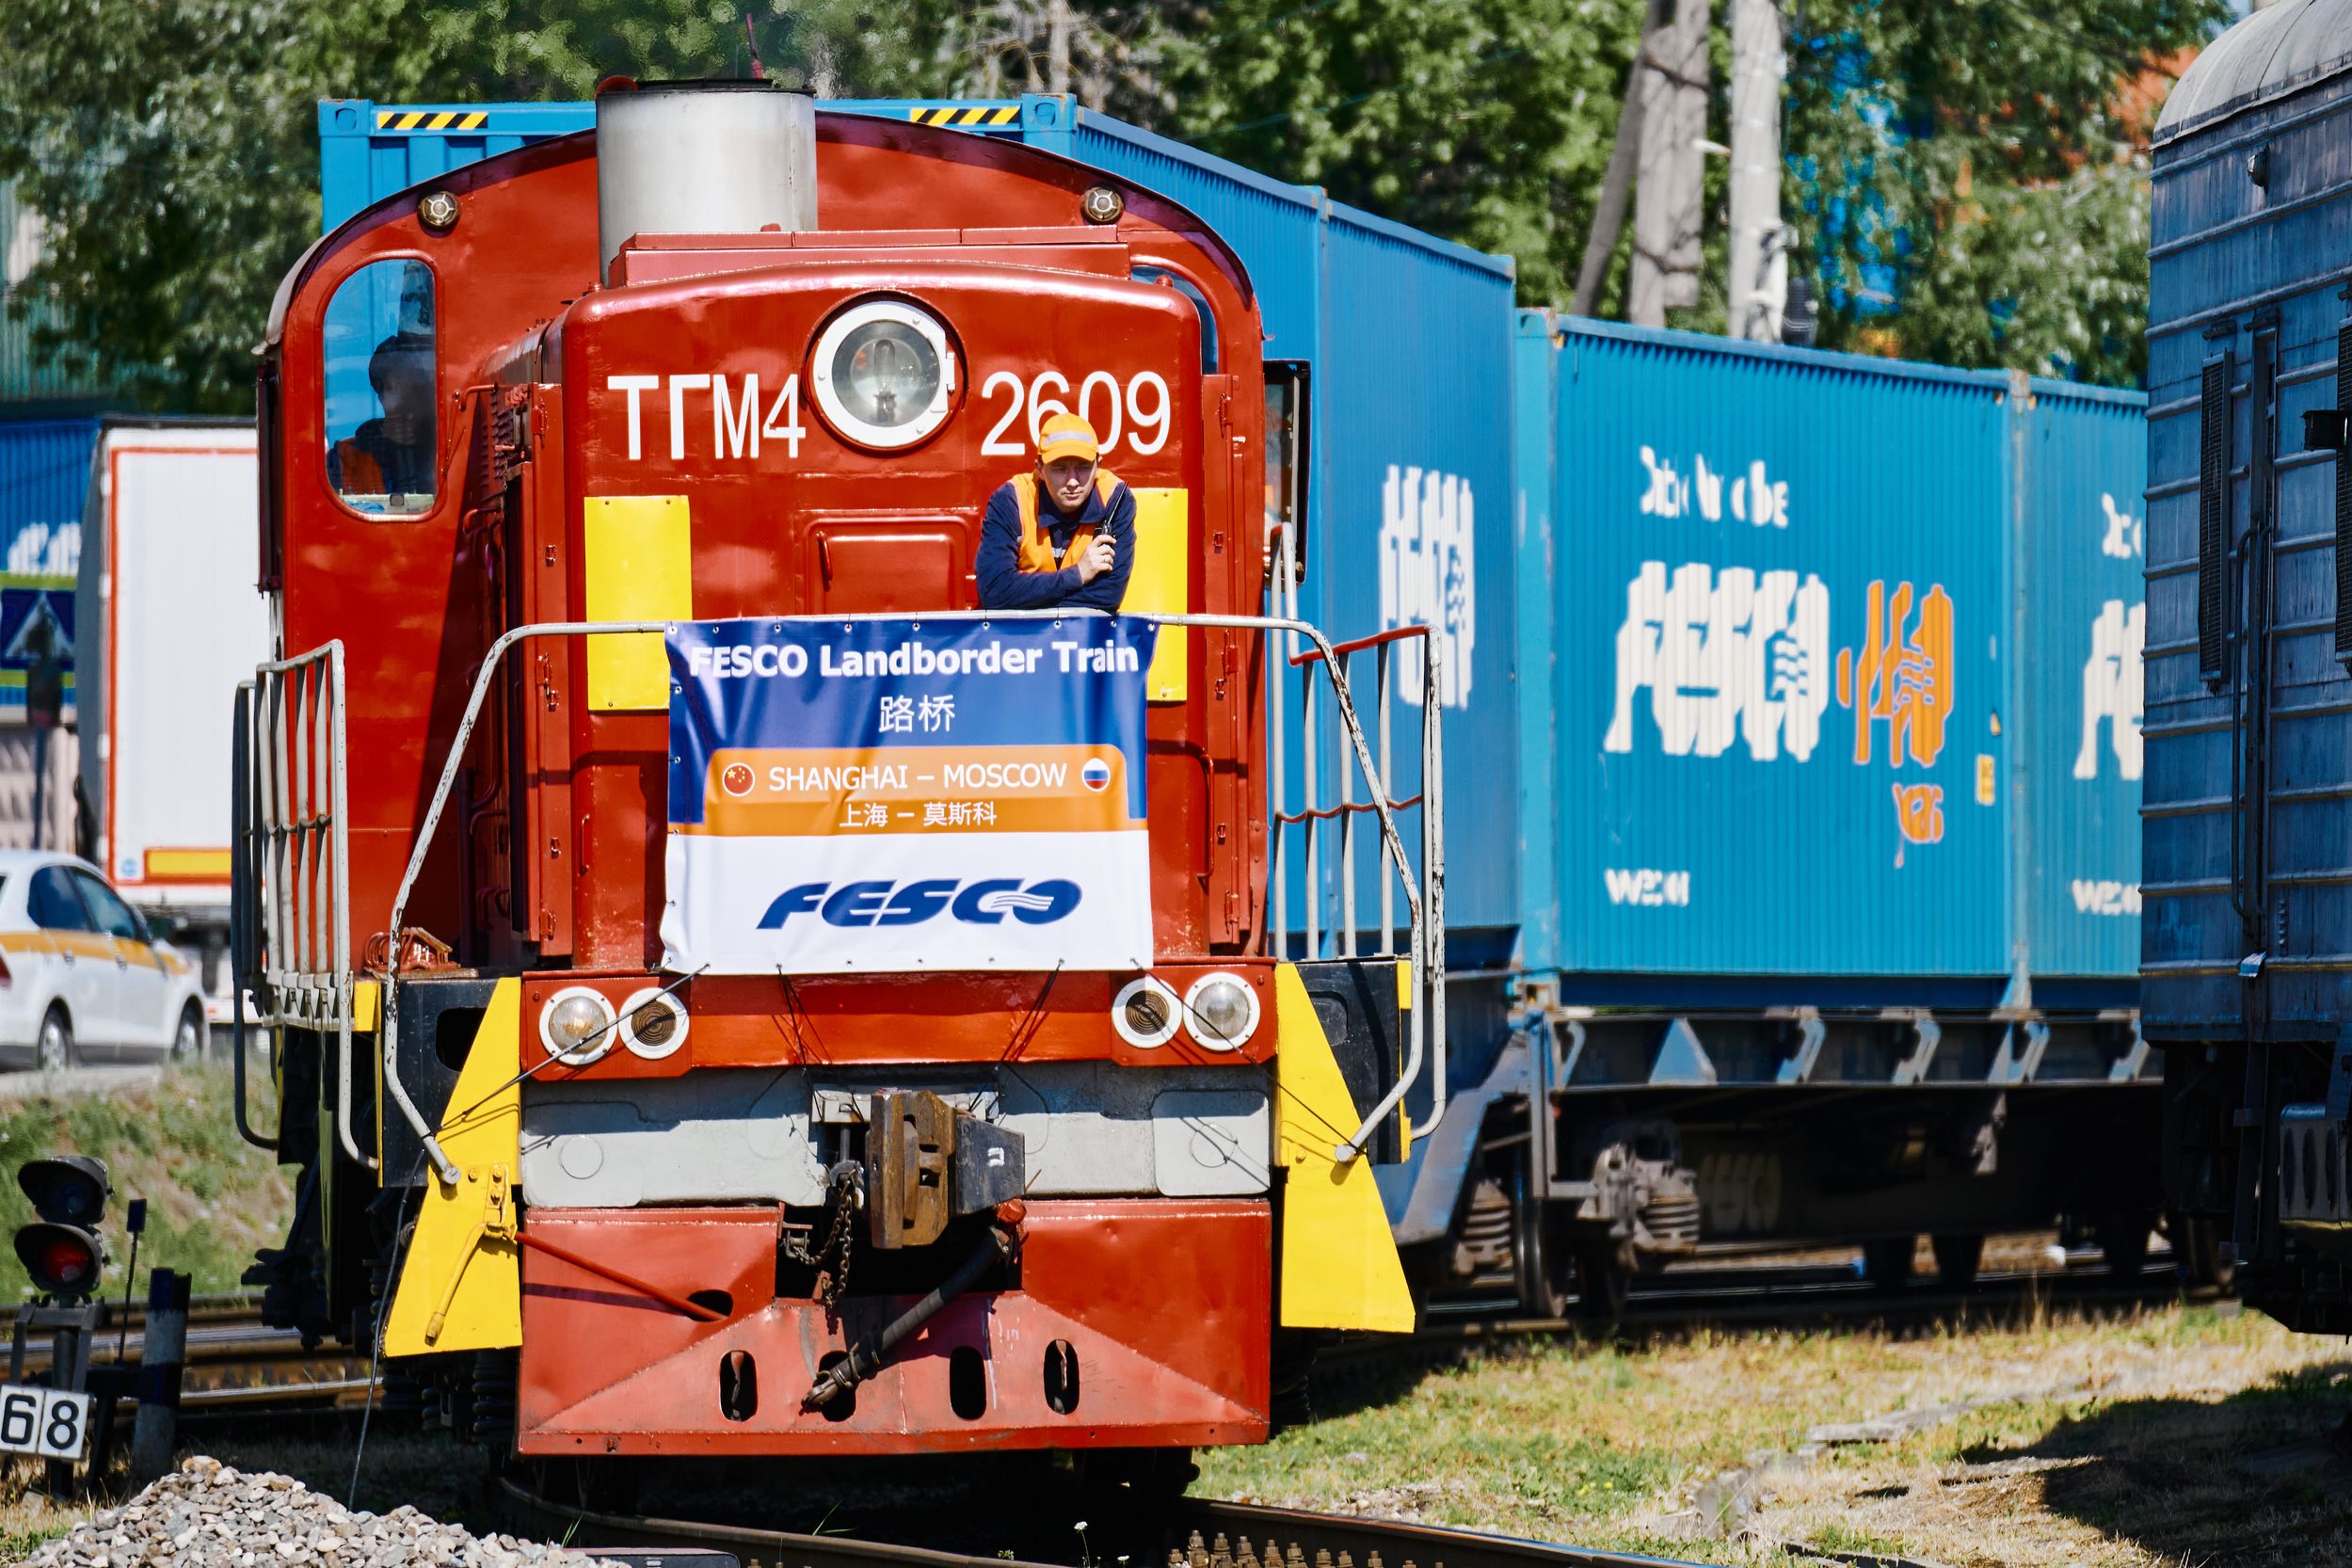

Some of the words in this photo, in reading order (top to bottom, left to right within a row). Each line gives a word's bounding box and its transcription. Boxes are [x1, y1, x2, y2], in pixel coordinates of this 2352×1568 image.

[607, 373, 807, 460] ТГМ4
[980, 370, 1171, 456] 2609
[690, 644, 808, 679] FESCO
[820, 641, 1044, 678] Landborder
[1051, 639, 1140, 674] Train
[878, 694, 956, 733] 路桥
[768, 764, 909, 792] SHANGHAI
[942, 761, 1068, 789] MOSCOW
[839, 803, 888, 827] 上海
[923, 801, 998, 826] 莫斯科
[756, 877, 1083, 931] FESCO
[1, 1393, 79, 1450] 68
